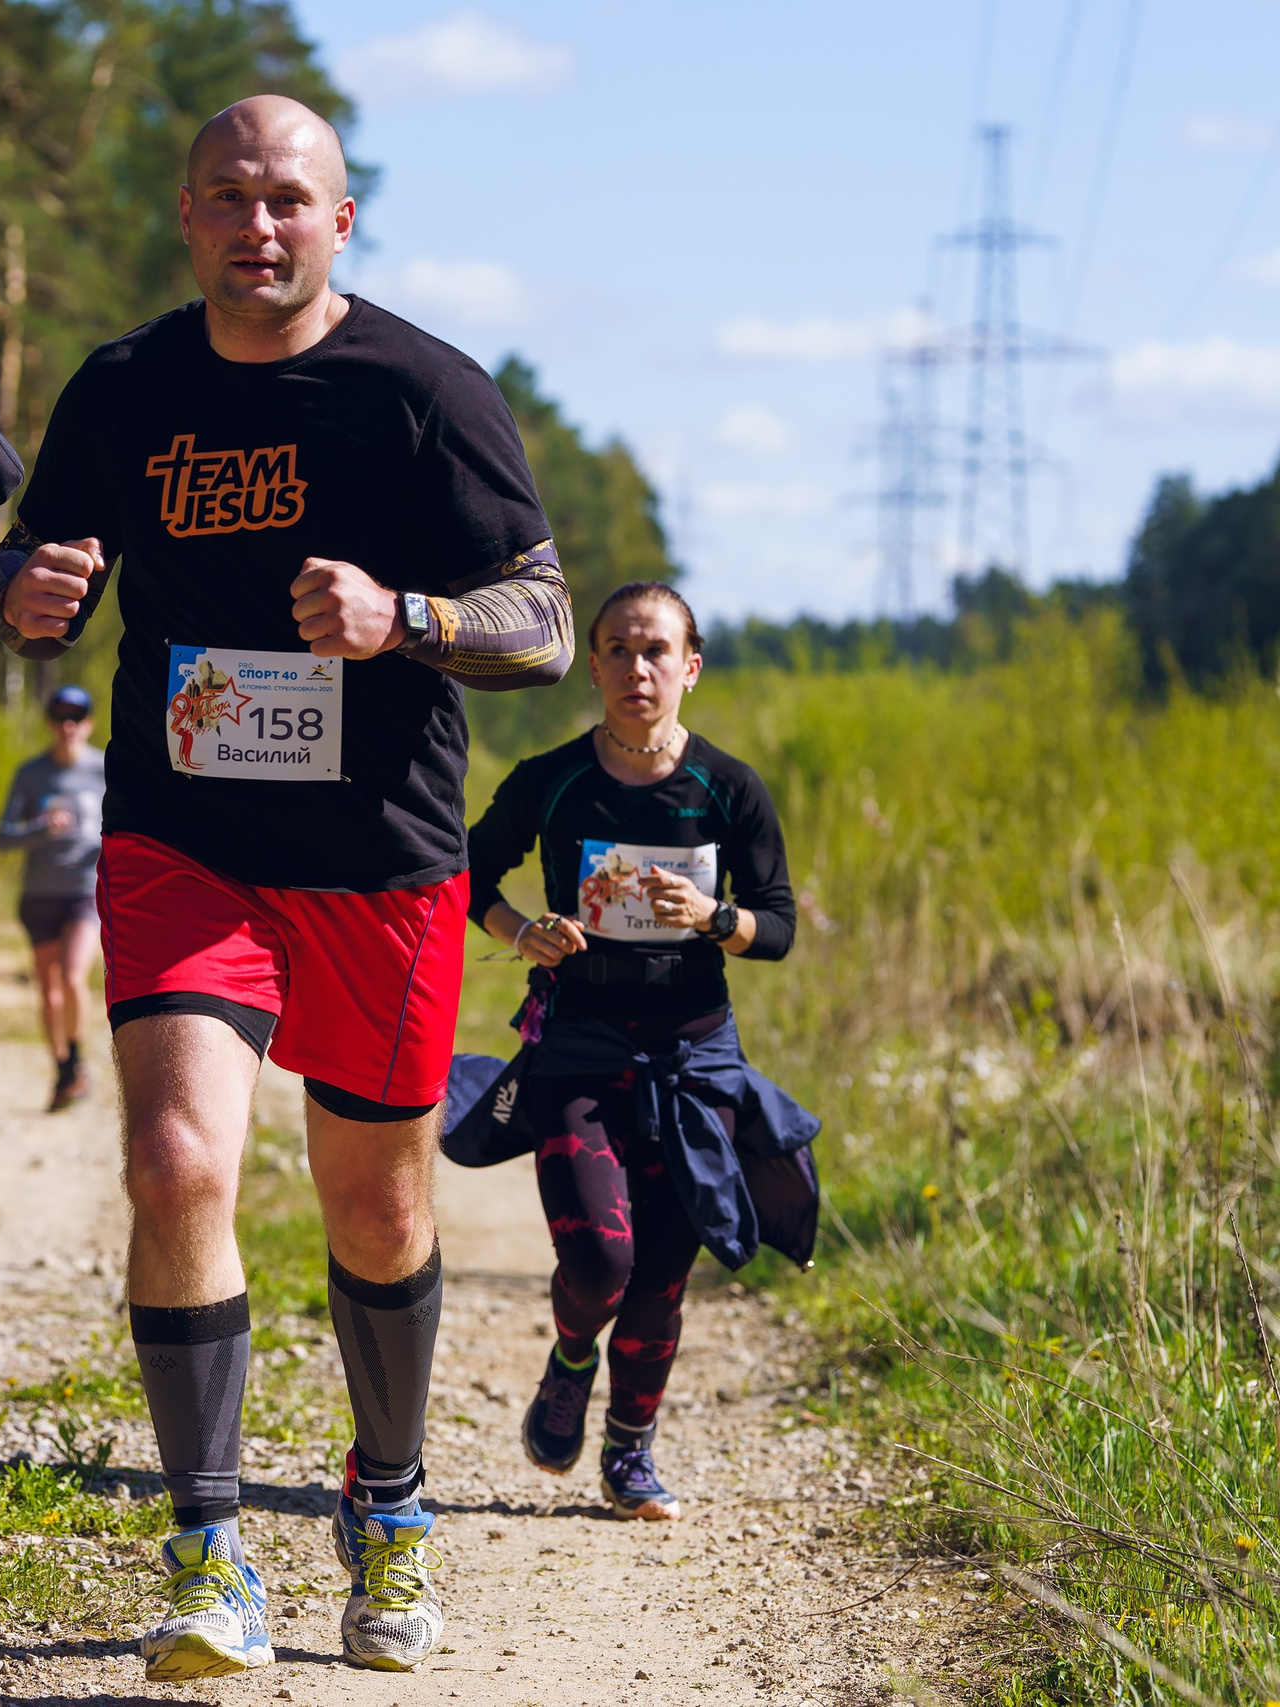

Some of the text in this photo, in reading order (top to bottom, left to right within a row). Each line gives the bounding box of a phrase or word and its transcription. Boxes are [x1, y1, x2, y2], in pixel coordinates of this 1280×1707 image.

[170, 482, 303, 534] JESUS
[238, 670, 280, 680] СПОРТ
[282, 670, 298, 680] 40
[249, 707, 324, 742] 158
[217, 744, 311, 764] Василий
